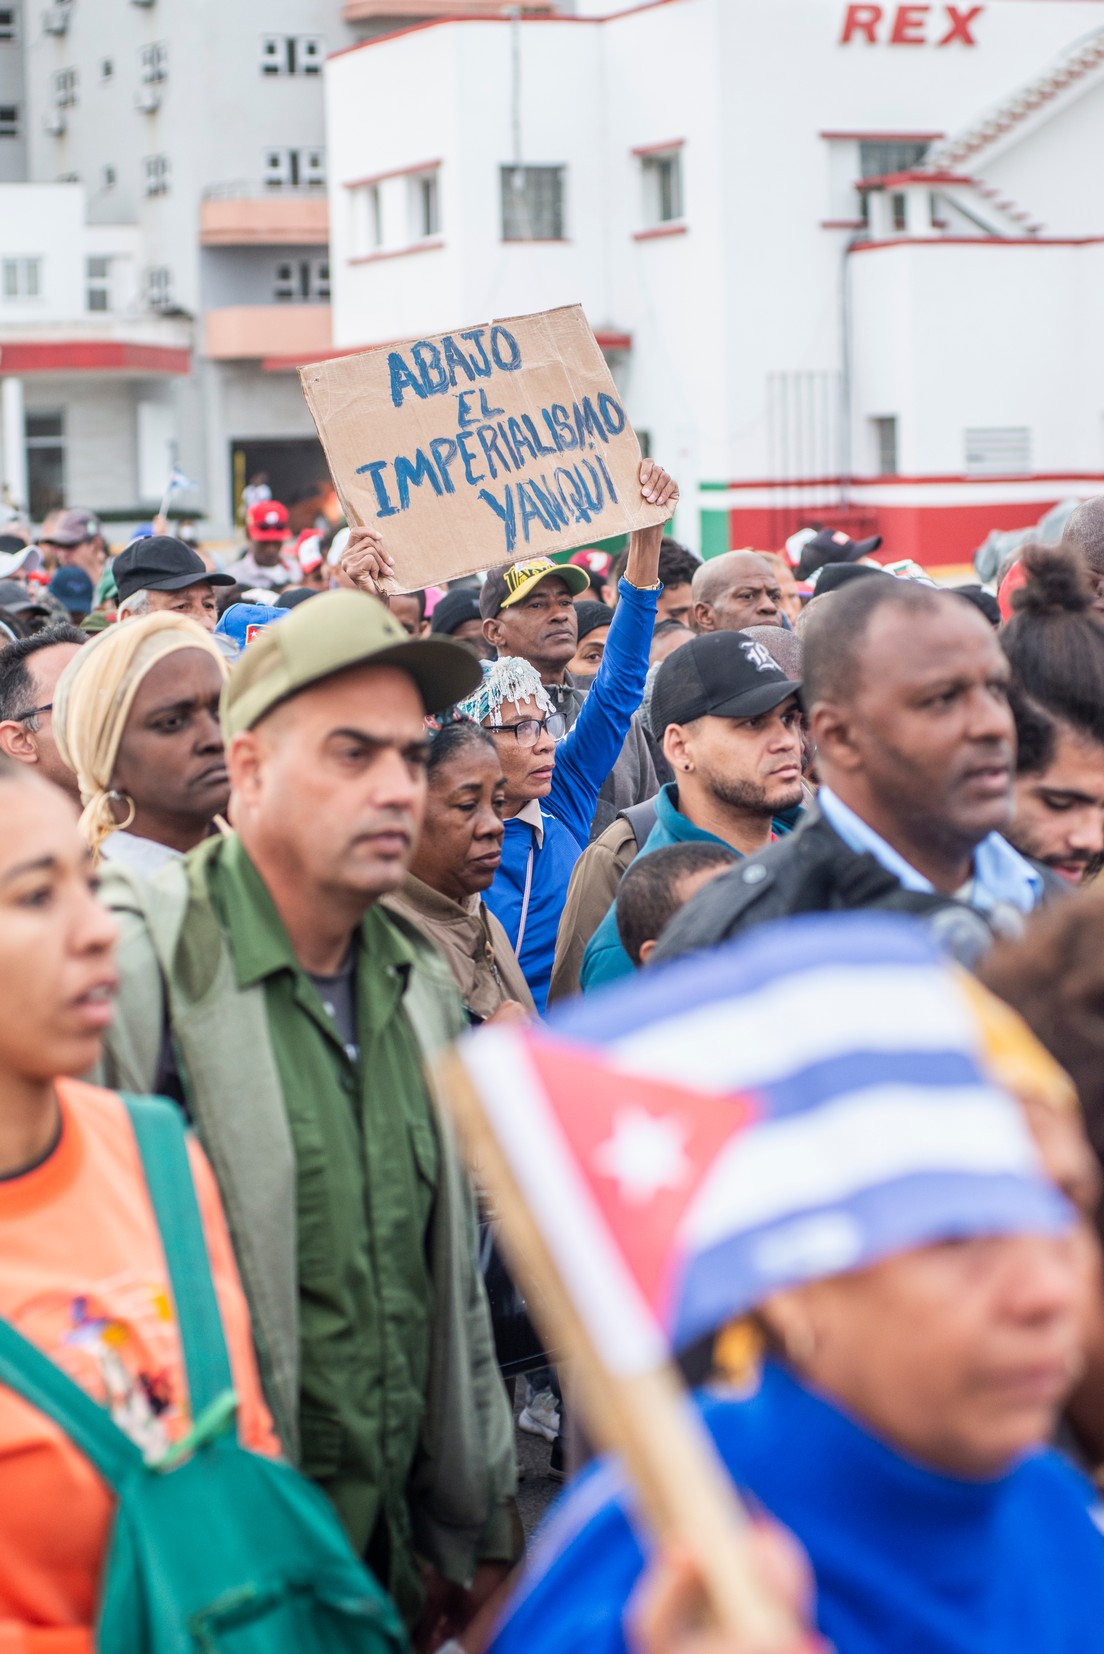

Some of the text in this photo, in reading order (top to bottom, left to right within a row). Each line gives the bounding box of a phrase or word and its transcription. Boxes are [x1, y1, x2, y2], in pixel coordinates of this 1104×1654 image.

[841, 4, 983, 46] REX
[387, 325, 523, 408] ABAJO
[456, 388, 505, 428] EL
[355, 391, 627, 518] IMPERIALISMO
[477, 455, 619, 553] YANQUI
